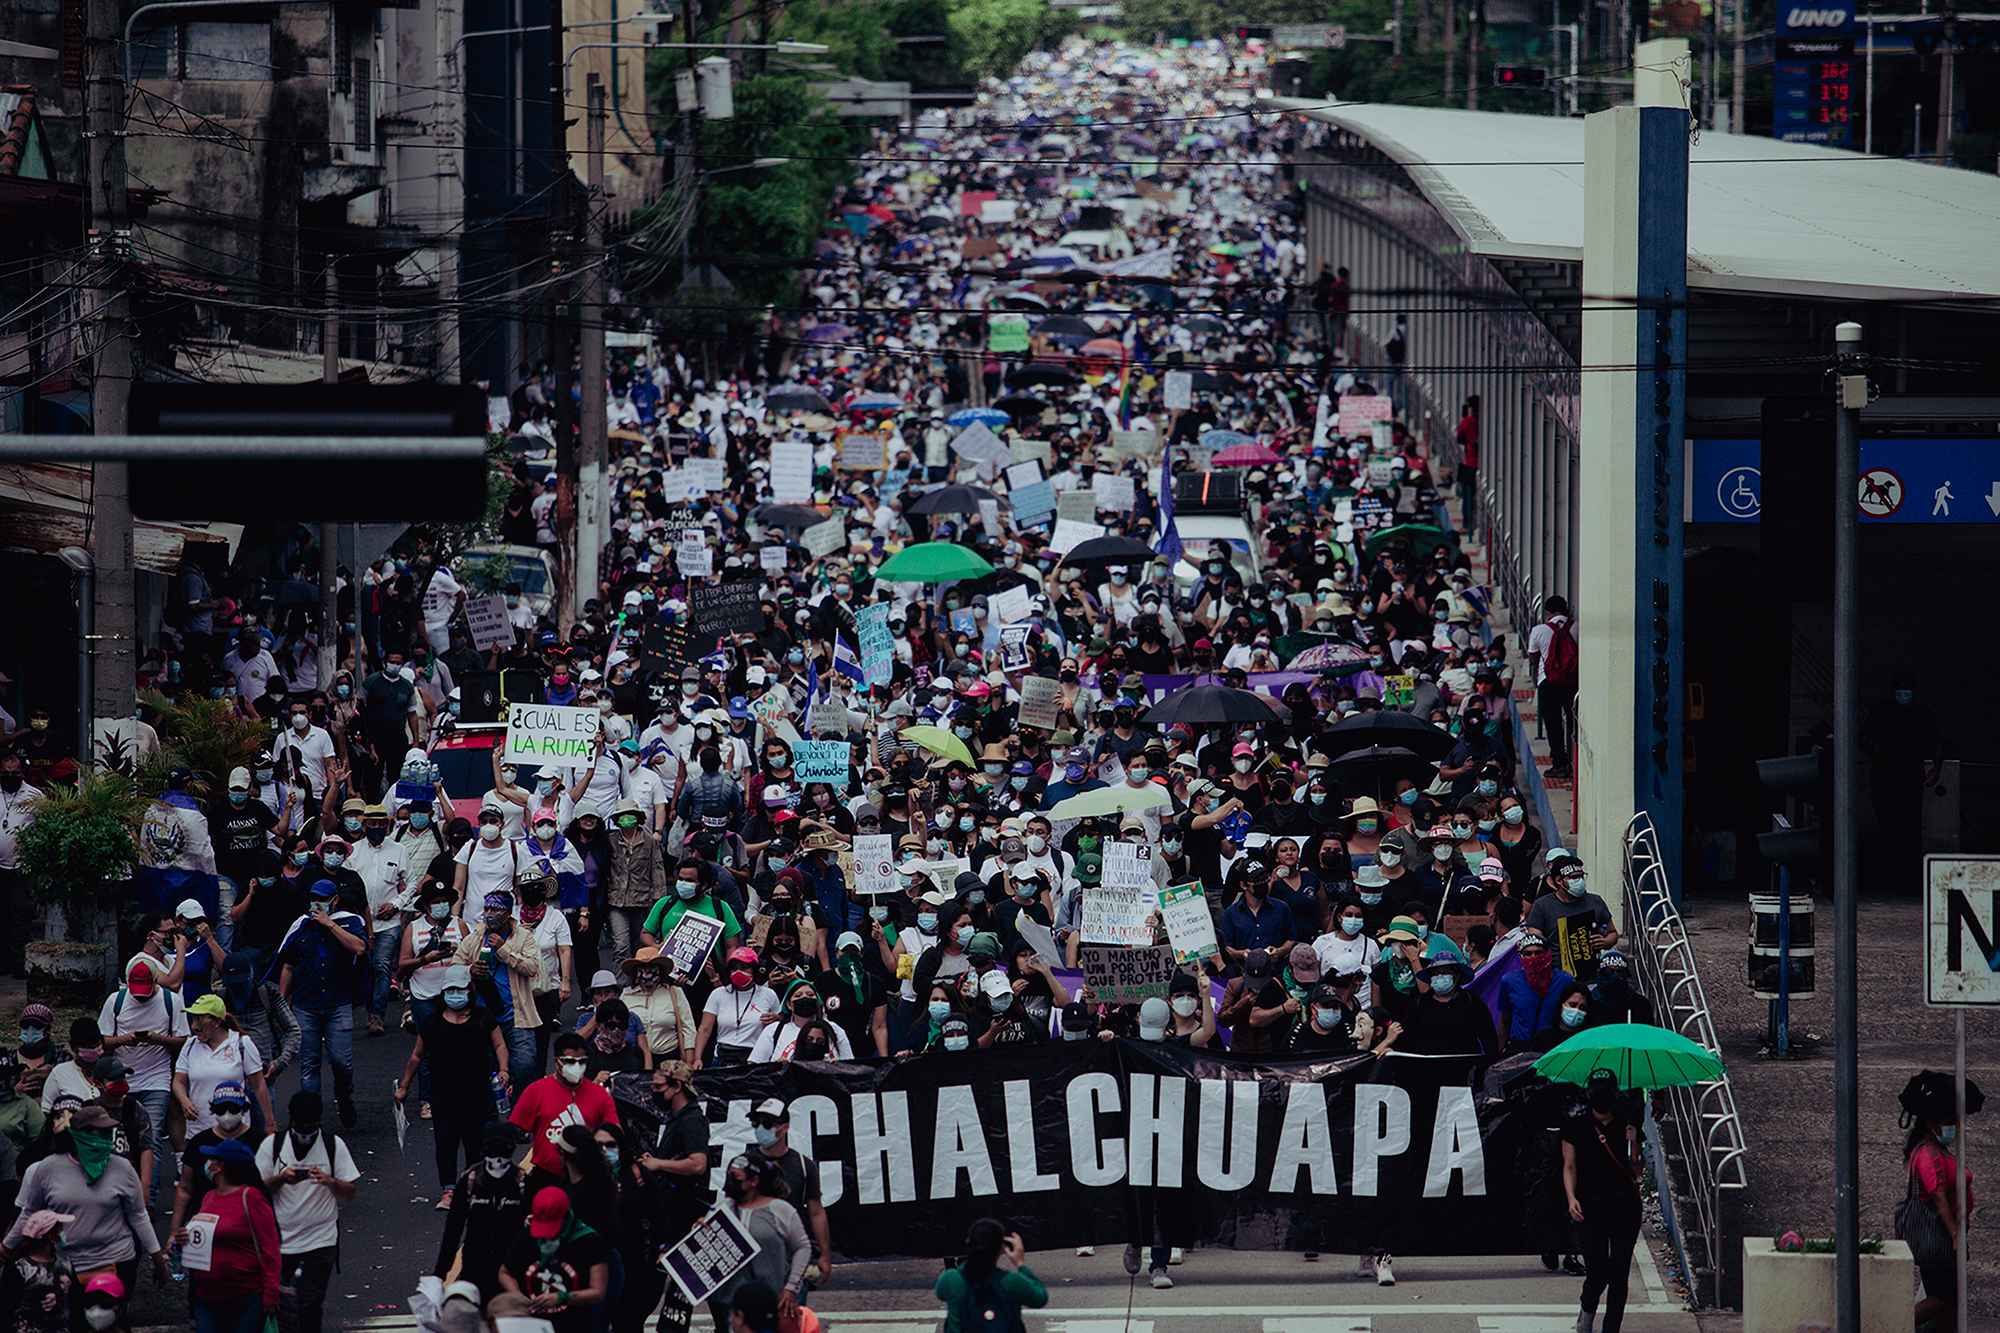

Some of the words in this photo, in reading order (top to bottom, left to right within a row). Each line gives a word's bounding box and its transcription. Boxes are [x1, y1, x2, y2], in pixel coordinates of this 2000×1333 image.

[1786, 7, 1846, 28] UNO
[512, 708, 566, 731] ¿CUÁL
[574, 713, 596, 733] ES
[514, 735, 536, 754] LA
[542, 736, 597, 762] RUTA?
[1083, 951, 1100, 963] YO
[1108, 948, 1161, 963] MARCHO
[1111, 963, 1135, 974] POR
[1140, 957, 1159, 972] UN
[1088, 975, 1115, 987] QUE
